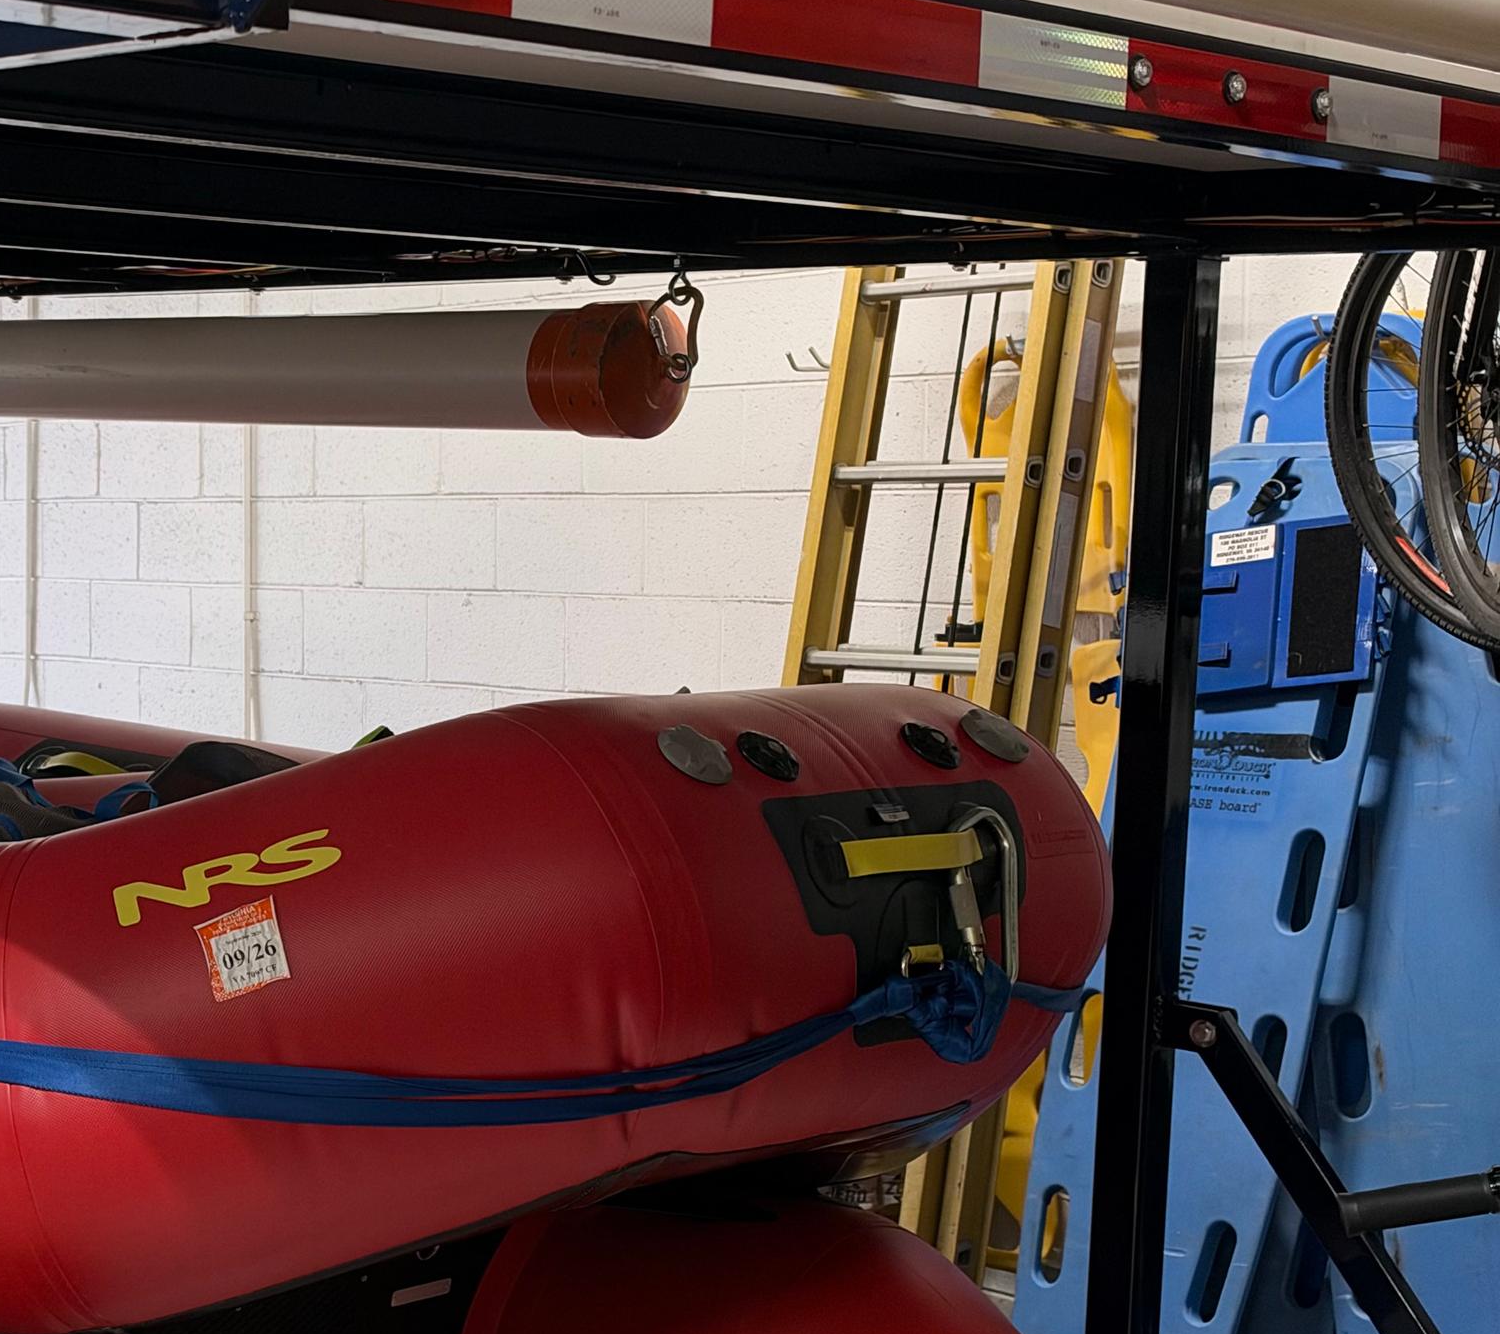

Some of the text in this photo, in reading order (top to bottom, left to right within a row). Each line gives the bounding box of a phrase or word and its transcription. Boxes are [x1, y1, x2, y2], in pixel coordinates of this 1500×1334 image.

[1190, 797, 1213, 810] ASE
[112, 828, 343, 928] NRS
[222, 939, 277, 970] 09/26
